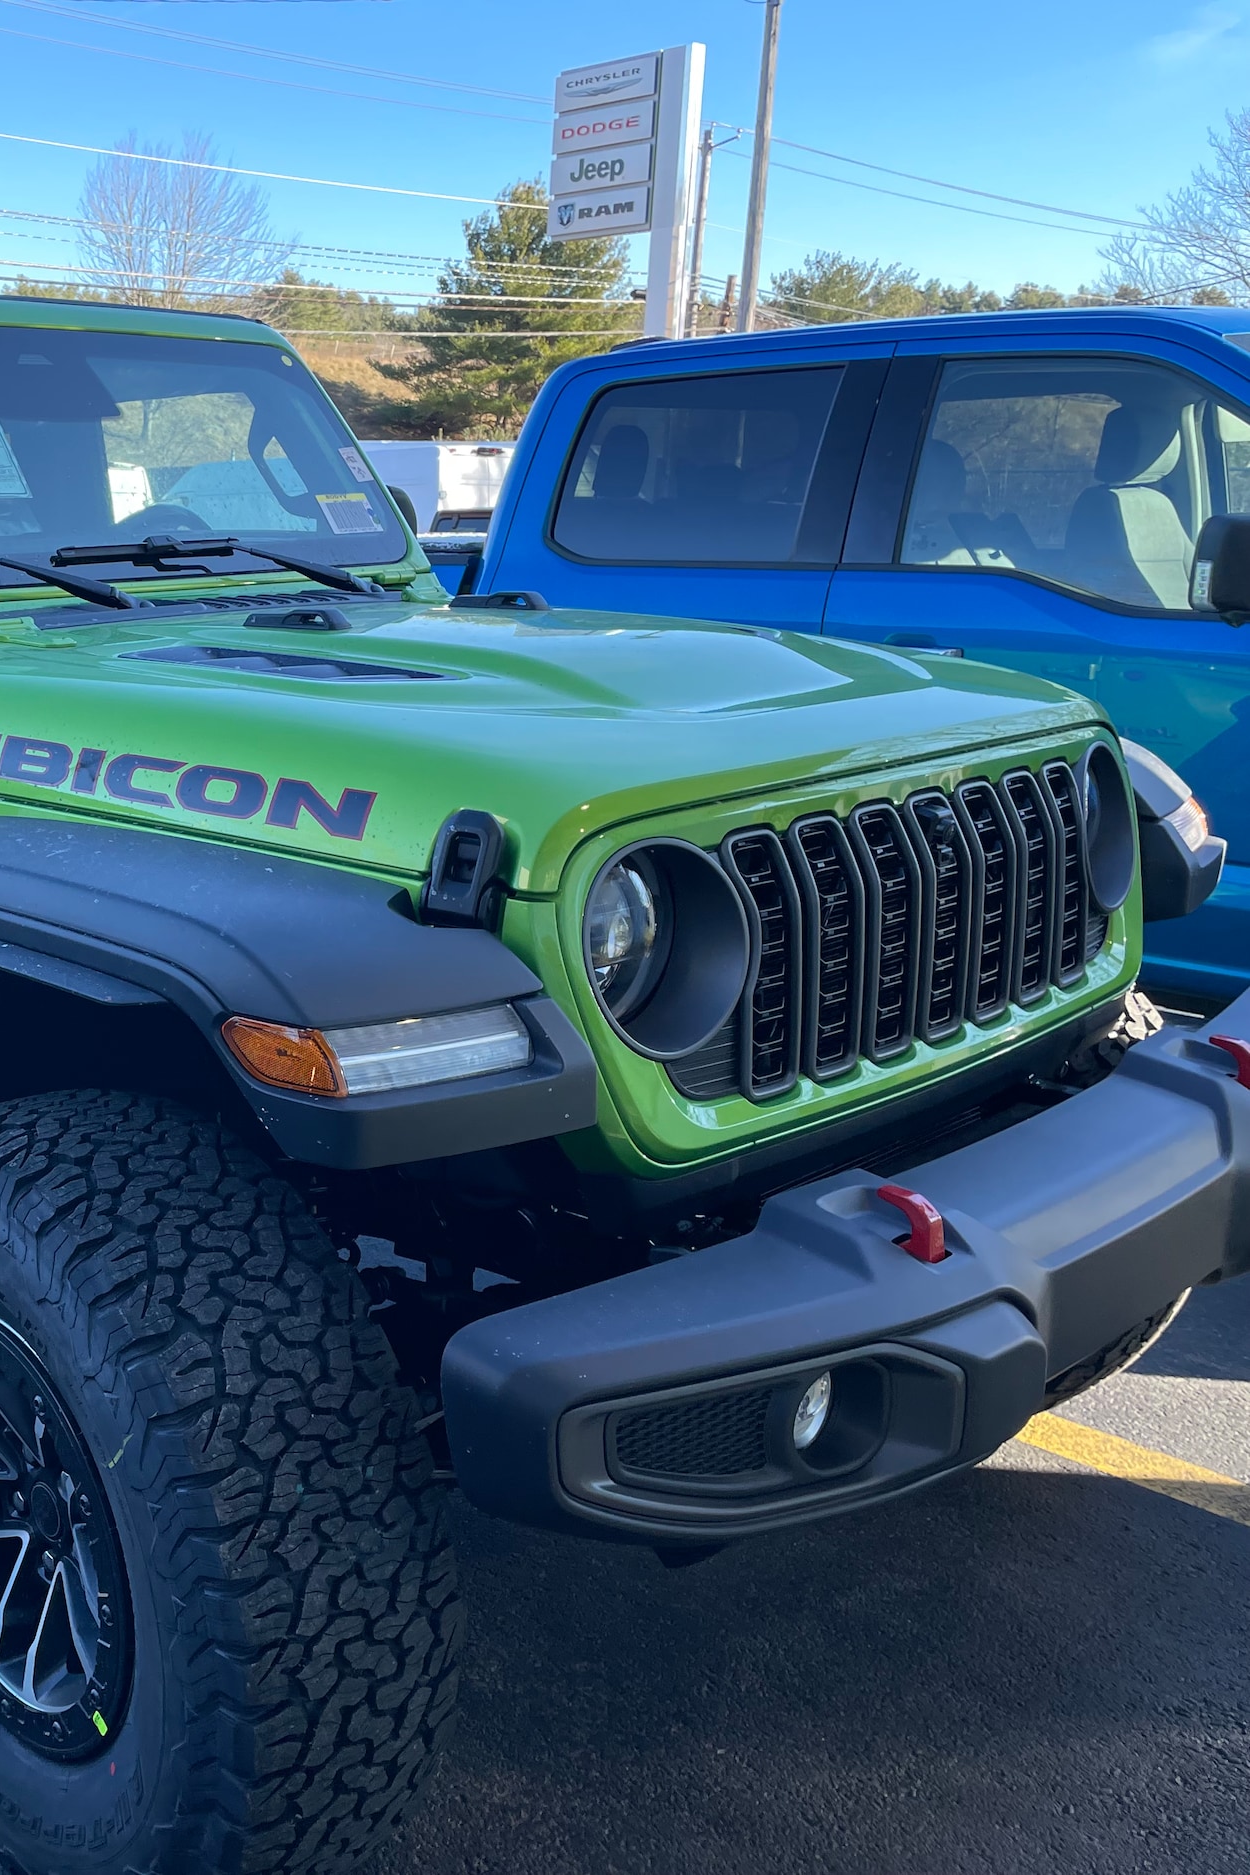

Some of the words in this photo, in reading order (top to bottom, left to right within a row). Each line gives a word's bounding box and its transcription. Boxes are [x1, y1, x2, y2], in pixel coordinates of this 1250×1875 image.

[565, 67, 641, 89] CHRYSLER
[561, 115, 640, 140] DODGE
[570, 157, 625, 183] Jeep
[578, 201, 635, 220] RAM
